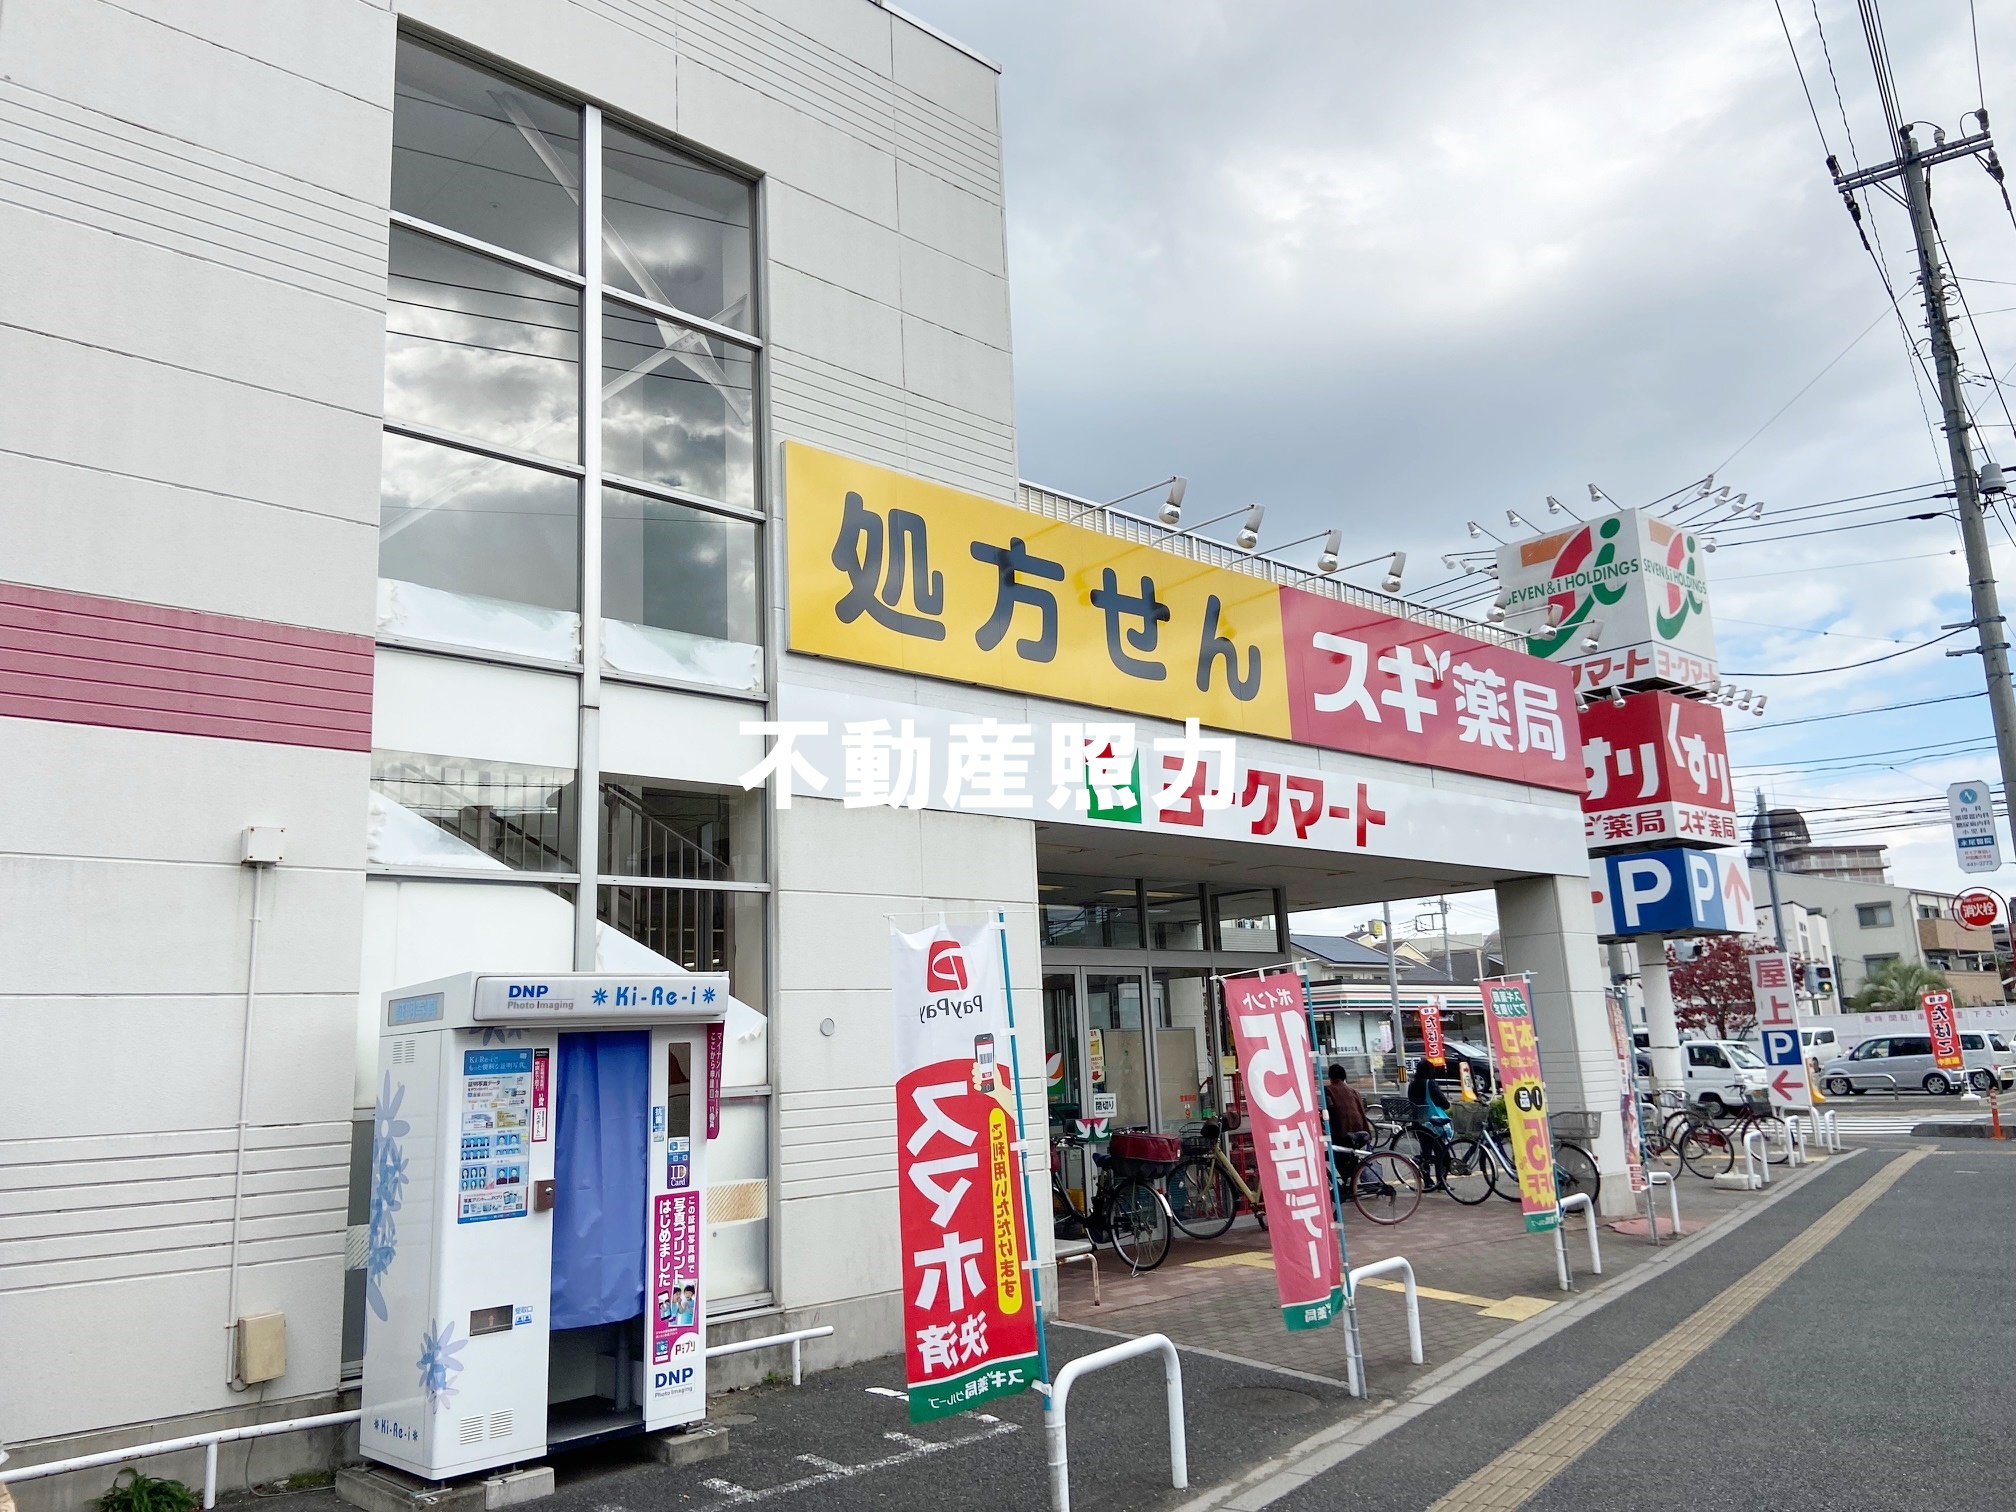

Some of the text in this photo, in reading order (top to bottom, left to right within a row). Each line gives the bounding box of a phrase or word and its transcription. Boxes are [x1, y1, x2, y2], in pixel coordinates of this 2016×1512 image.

[1565, 558, 1639, 589] HOLDINGS
[1672, 571, 1707, 595] HOLDINGS
[832, 491, 1261, 701] 処方せん
[1657, 650, 1718, 683] ヨークマート
[1312, 631, 1566, 761] スギ薬局
[1667, 703, 1730, 805] くすり
[1678, 810, 1736, 840] スギ薬局
[1618, 858, 1672, 928] P
[1689, 854, 1715, 922] P
[1962, 901, 1996, 918] 消火栓
[507, 1000, 574, 1010] Photo Imaging
[508, 985, 549, 998] DNP
[615, 985, 696, 1006] Ki-Re-i
[1755, 958, 1793, 1025] 屋上
[1768, 1031, 1793, 1064] P
[670, 1178, 686, 1187] Card
[671, 1164, 687, 1179] ID
[658, 1199, 671, 1287] はじめました
[674, 1197, 686, 1285] 写真プリント
[655, 1367, 693, 1389] DNP
[655, 1386, 693, 1399] Photo Imaging
